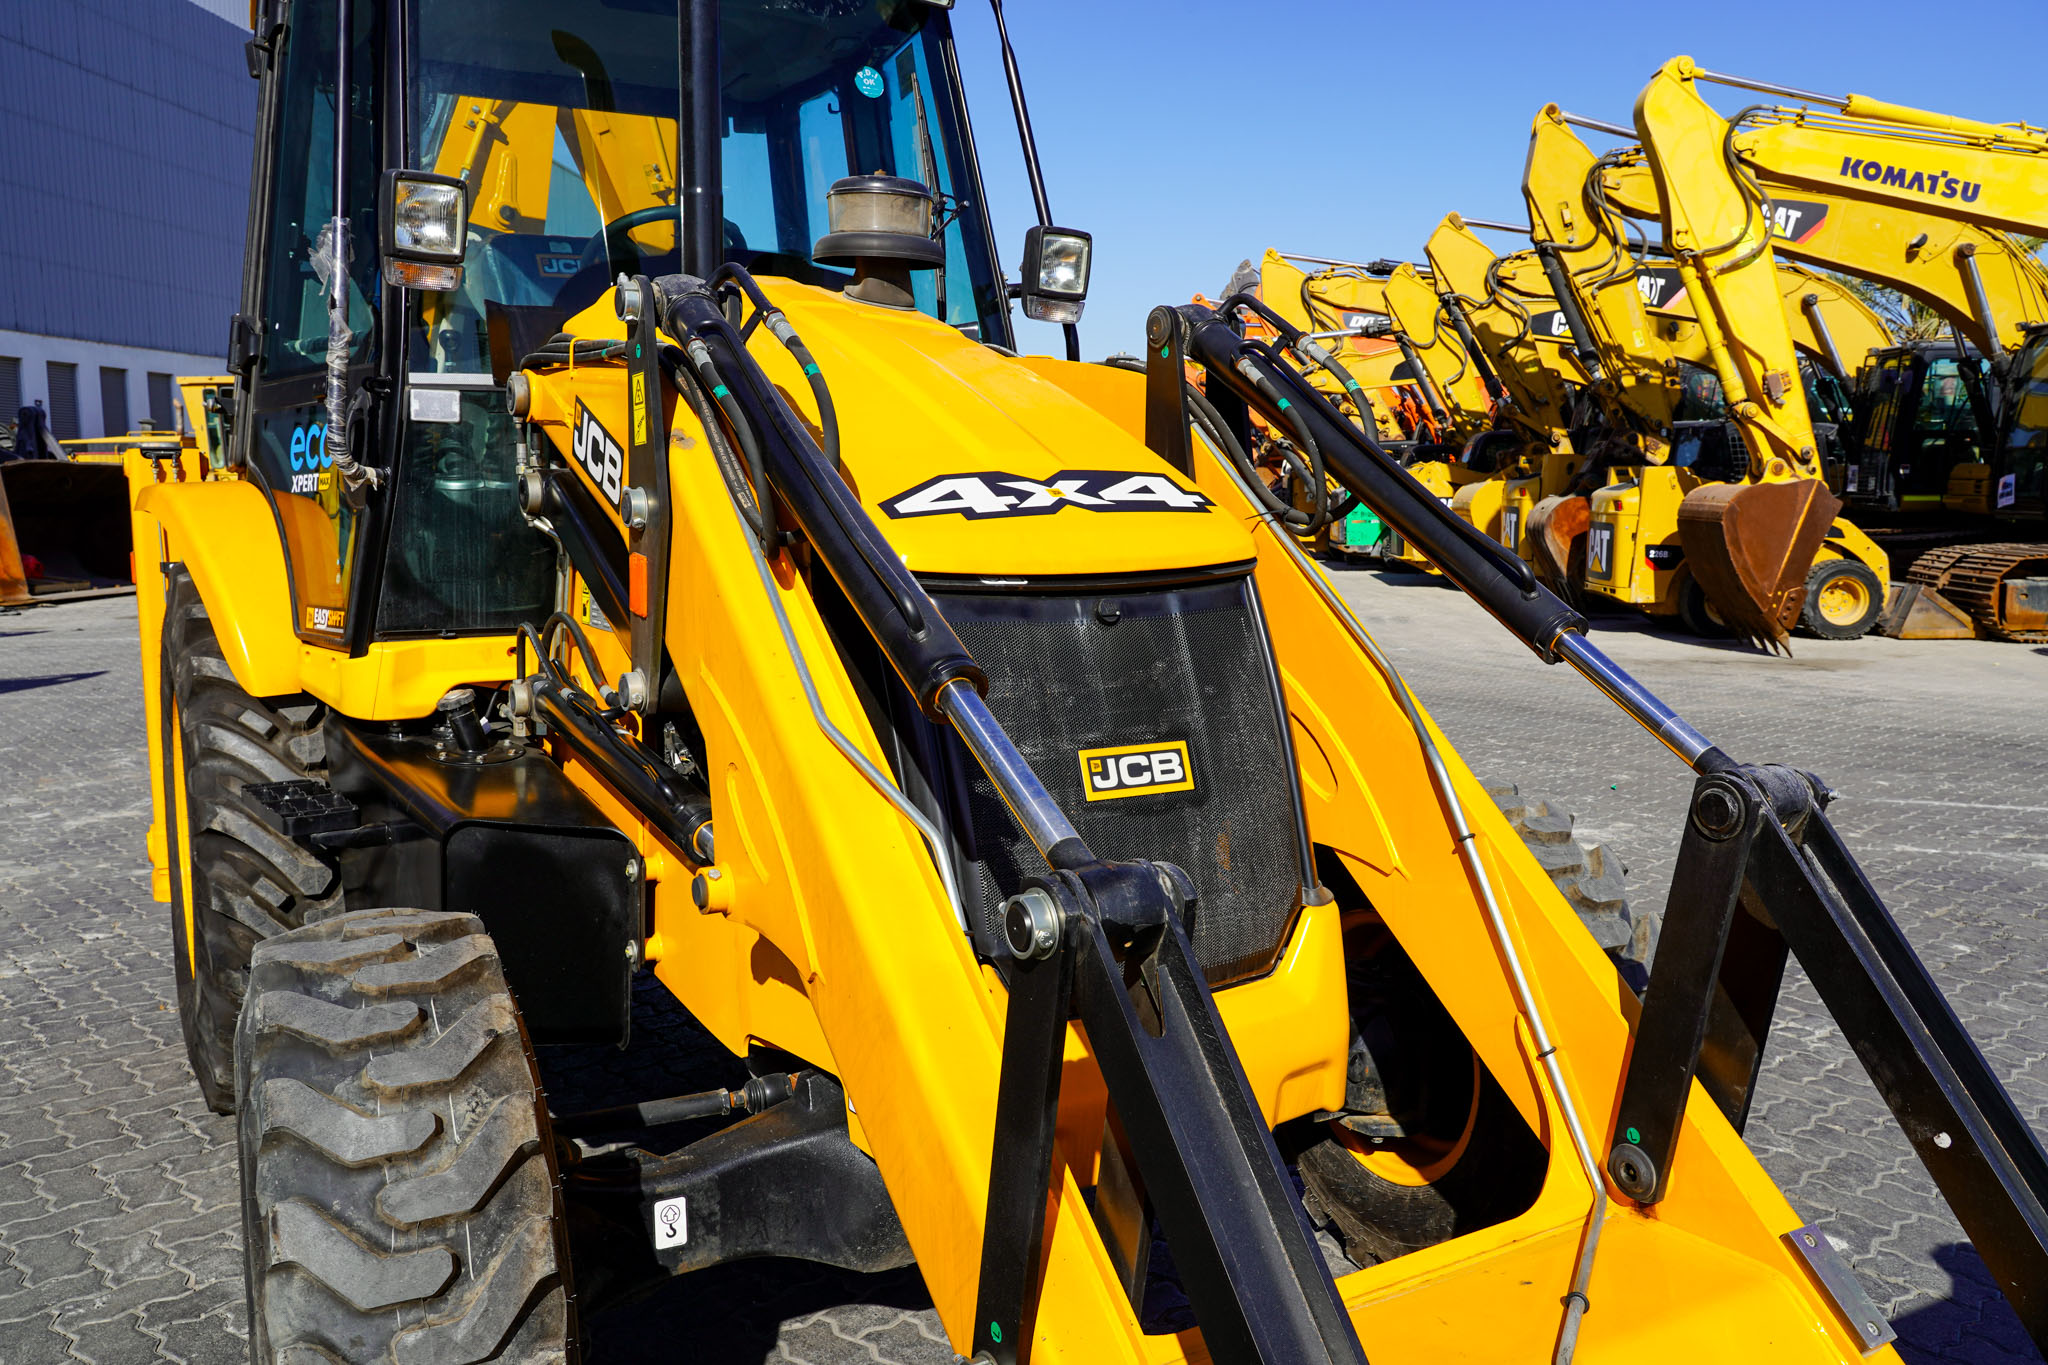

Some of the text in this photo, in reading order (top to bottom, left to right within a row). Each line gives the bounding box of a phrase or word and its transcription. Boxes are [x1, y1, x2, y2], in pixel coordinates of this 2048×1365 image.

[863, 78, 876, 86] OK
[1840, 156, 1982, 203] KOMATSU
[544, 259, 581, 274] JC
[1637, 275, 1666, 306] AT
[574, 411, 622, 505] JCB
[291, 473, 319, 493] XPERT
[1588, 528, 1610, 573] CAT
[1092, 752, 1184, 789] JCB
